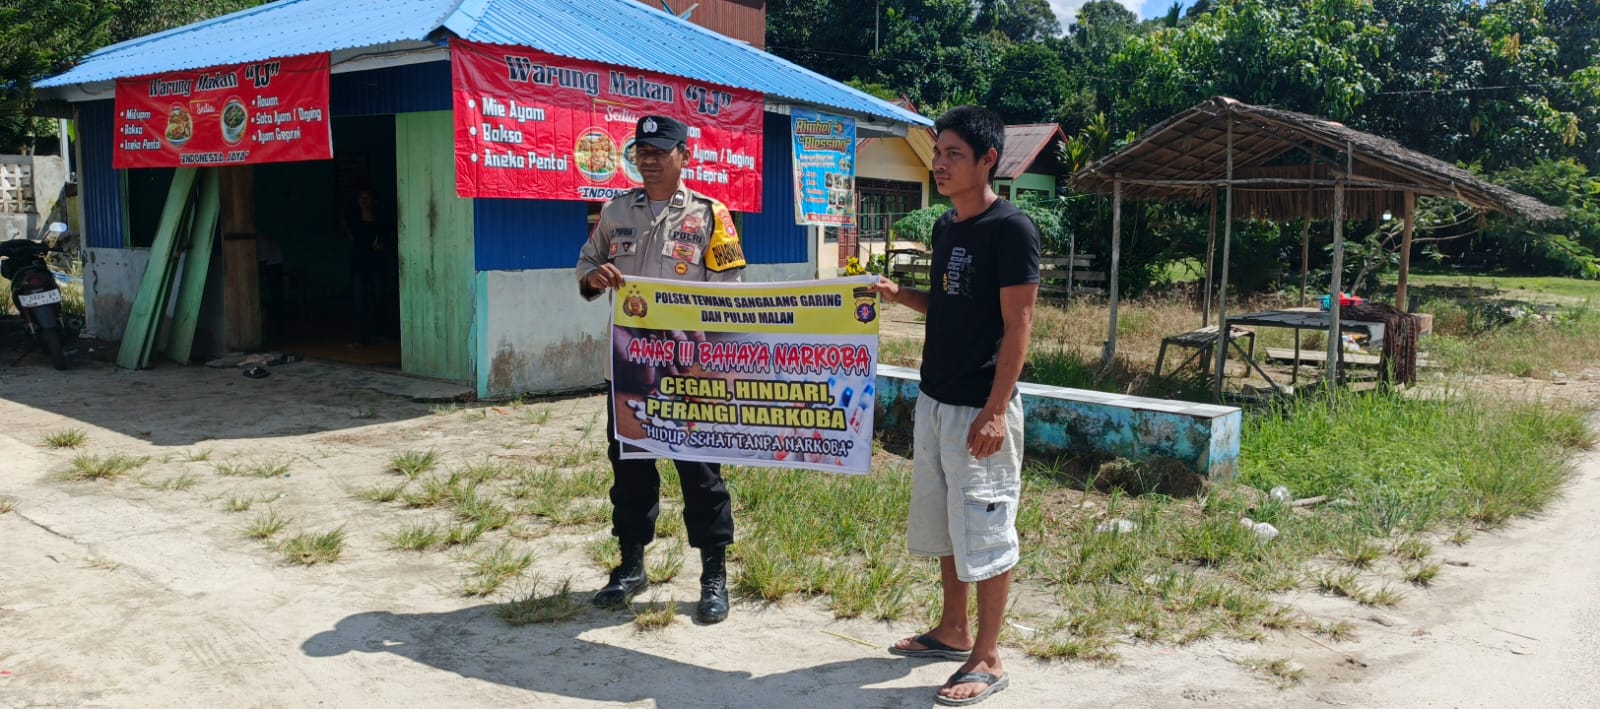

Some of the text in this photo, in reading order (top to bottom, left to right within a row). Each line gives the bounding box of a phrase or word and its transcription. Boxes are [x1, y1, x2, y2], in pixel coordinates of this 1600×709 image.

[149, 79, 193, 97] Warung
[197, 73, 238, 92] Makan
[504, 55, 600, 96] Warung
[608, 70, 674, 103] Makan
[256, 111, 272, 124] Soto
[482, 97, 545, 122] Mie Ayam
[124, 124, 143, 135] Bakso
[482, 123, 523, 144] Bakso
[795, 119, 832, 136] Bimbel
[484, 148, 568, 171] Aneka Pentol
[693, 143, 755, 170] Ayam / Daging
[697, 166, 729, 185] Geprek
[672, 231, 703, 244] POLRI
[655, 291, 842, 309] POLSEK TEWANG SANGALANG GARING
[701, 310, 794, 325] DAN PULAU MALAN
[627, 338, 871, 376] AWAS !!! BAHAYA NARKOBA
[660, 376, 834, 404] CEGAH, HINDARI,
[646, 399, 846, 430] PERANGI NARKOBA
[641, 423, 853, 457] "HIDUP SEHAT TANPA NARKOBA"
